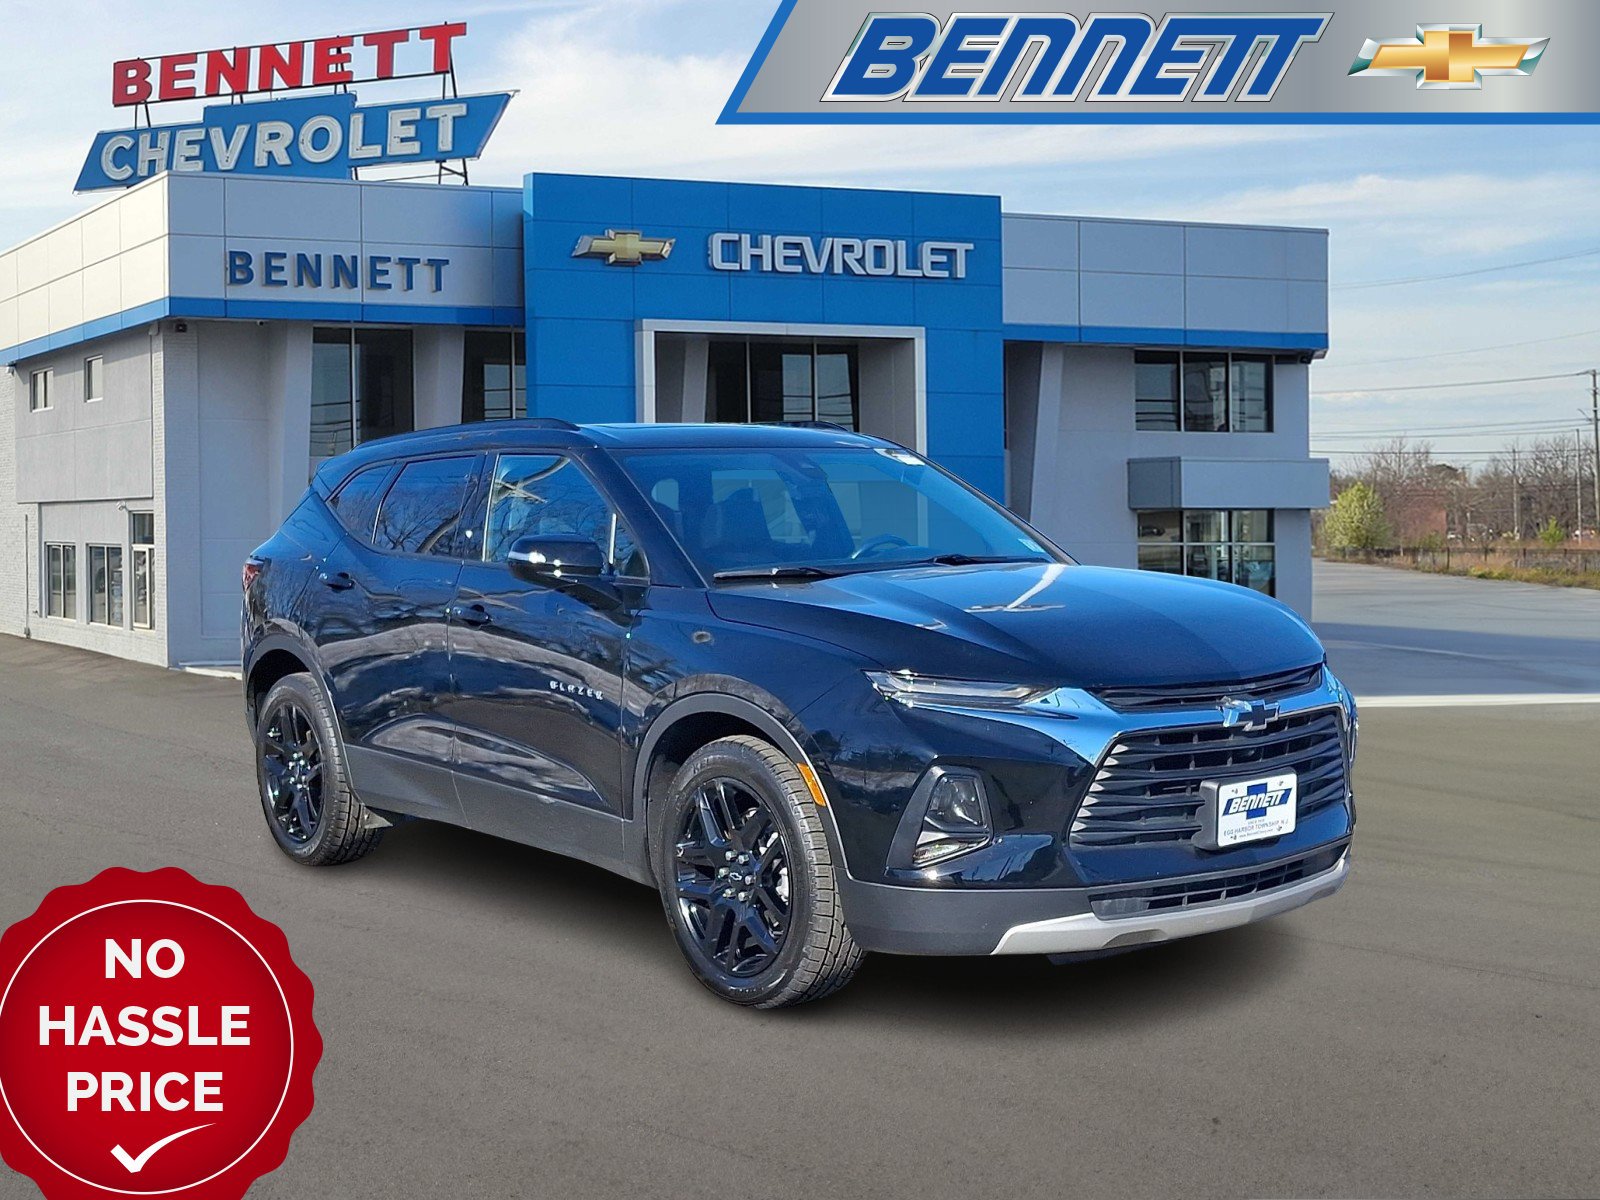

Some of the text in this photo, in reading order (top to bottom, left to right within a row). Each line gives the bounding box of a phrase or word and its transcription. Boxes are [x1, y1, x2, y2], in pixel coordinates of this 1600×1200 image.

[112, 22, 467, 107] BENNETT
[100, 103, 467, 181] CHEVROLET
[226, 250, 450, 293] BENNETT
[708, 232, 974, 279] CHEVROLET
[549, 680, 604, 701] BLAZER
[1228, 789, 1286, 815] BENNETT
